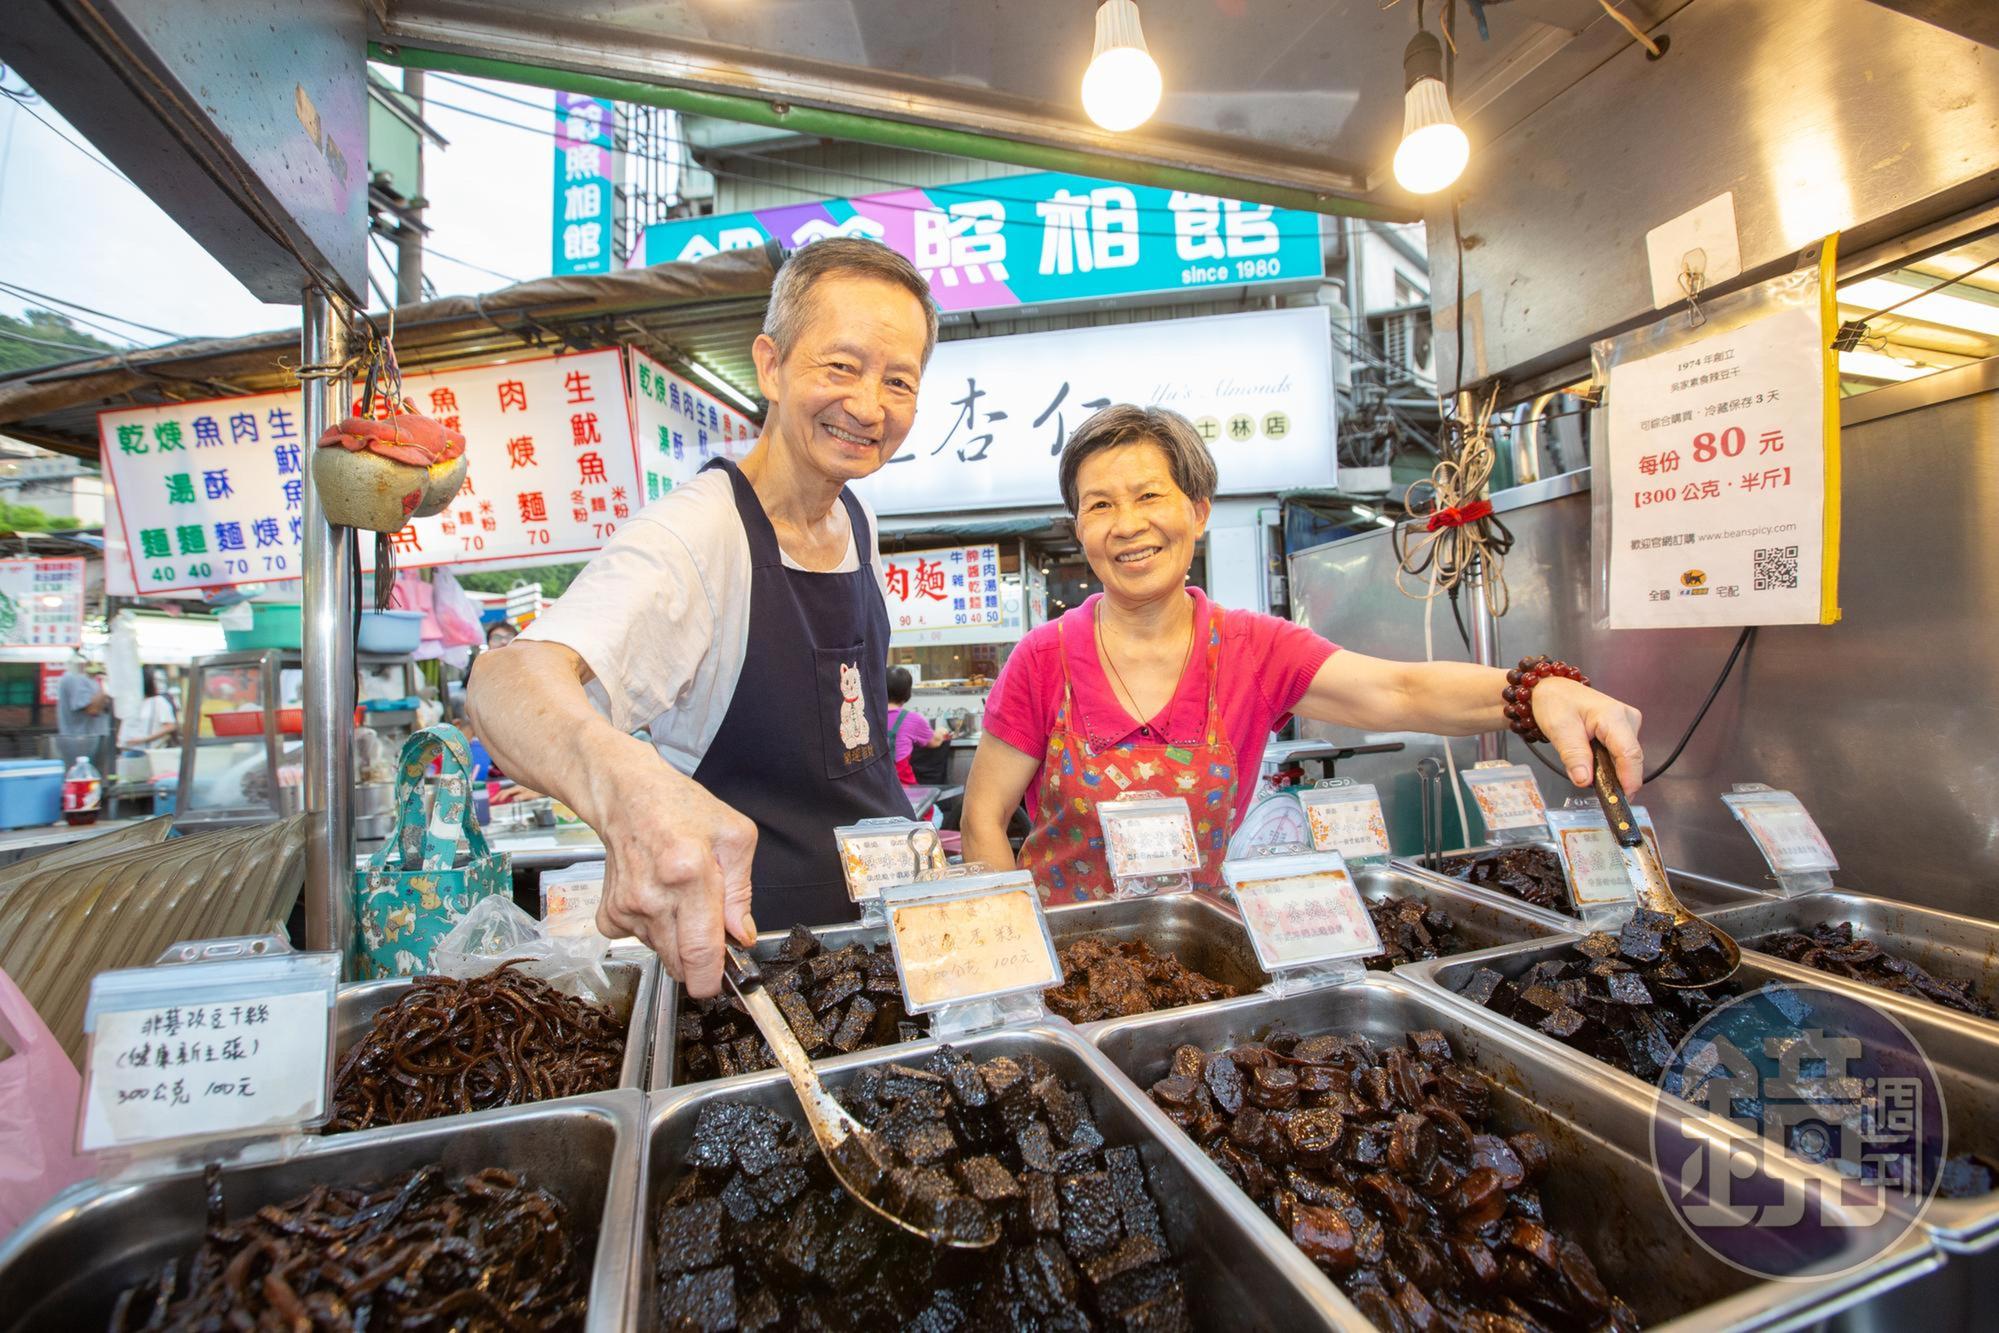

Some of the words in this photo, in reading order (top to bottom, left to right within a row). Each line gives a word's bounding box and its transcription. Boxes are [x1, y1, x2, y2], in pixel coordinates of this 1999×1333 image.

[677, 187, 1280, 288] 照相館
[1181, 265, 1228, 285] since
[1236, 257, 1281, 279] 1980
[1677, 358, 1701, 371] 1974
[1756, 394, 1763, 404] 3
[1767, 389, 1780, 403] 天
[1198, 415, 1286, 438] 士林店
[1639, 449, 1680, 475] 每份
[1693, 426, 1746, 463] 80
[1759, 430, 1784, 455] 元
[528, 529, 550, 545] 70
[593, 523, 615, 540] 70
[1698, 522, 1797, 542] www.beanspicy.com
[461, 536, 484, 552] 70
[188, 563, 212, 578] 40
[225, 559, 249, 574] 70
[263, 555, 287, 571] 70
[152, 566, 175, 581] 40
[1716, 585, 1740, 598] 宅配
[900, 615, 911, 626] 90
[955, 613, 967, 624] 90
[970, 613, 982, 623] 40
[986, 611, 998, 622] 50
[203, 1076, 256, 1098] 100元
